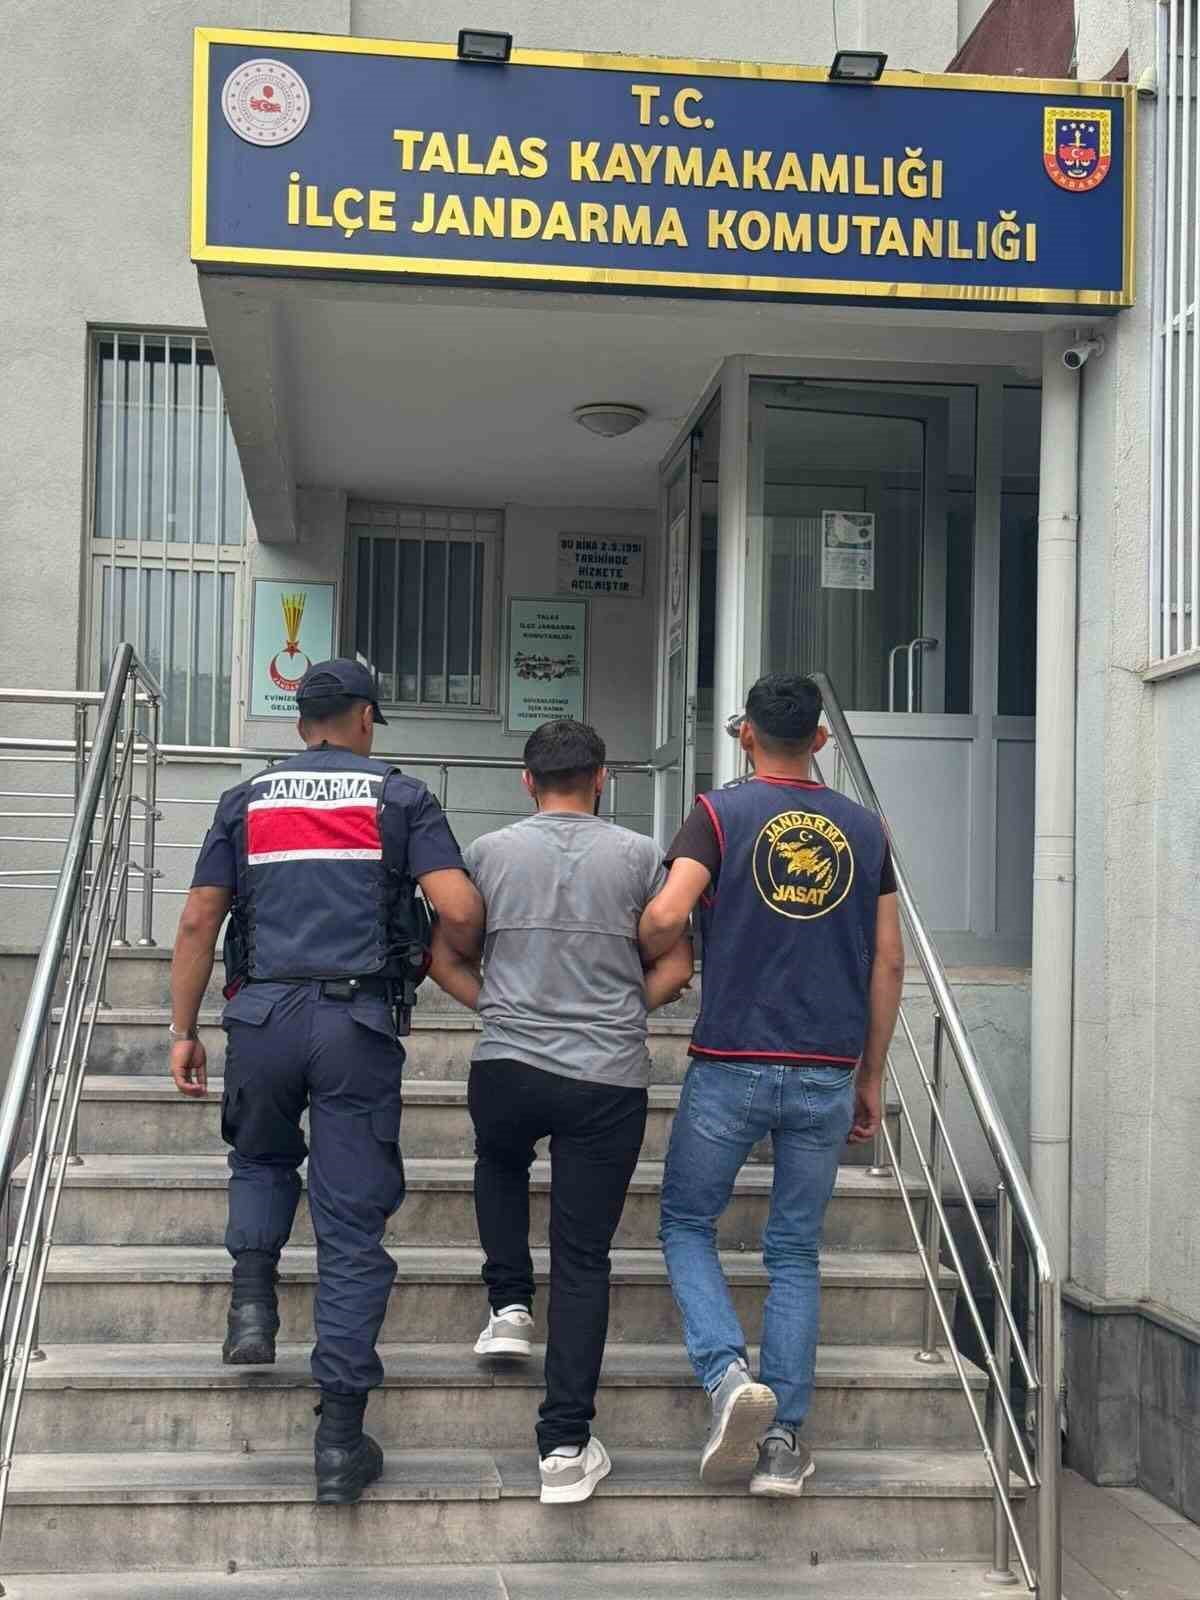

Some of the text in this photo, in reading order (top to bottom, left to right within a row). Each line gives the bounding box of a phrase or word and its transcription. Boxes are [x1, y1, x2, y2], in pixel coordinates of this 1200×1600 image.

[630, 84, 715, 129] T.C.
[393, 129, 943, 199] TALAS KAYMAKAMLIĞI
[287, 171, 1037, 263] İLÇE JANDARMA KOMUTANLIĞI
[262, 779, 372, 801] JANDARMA
[763, 814, 848, 852] JANDARMA
[772, 884, 828, 907] JASAT
